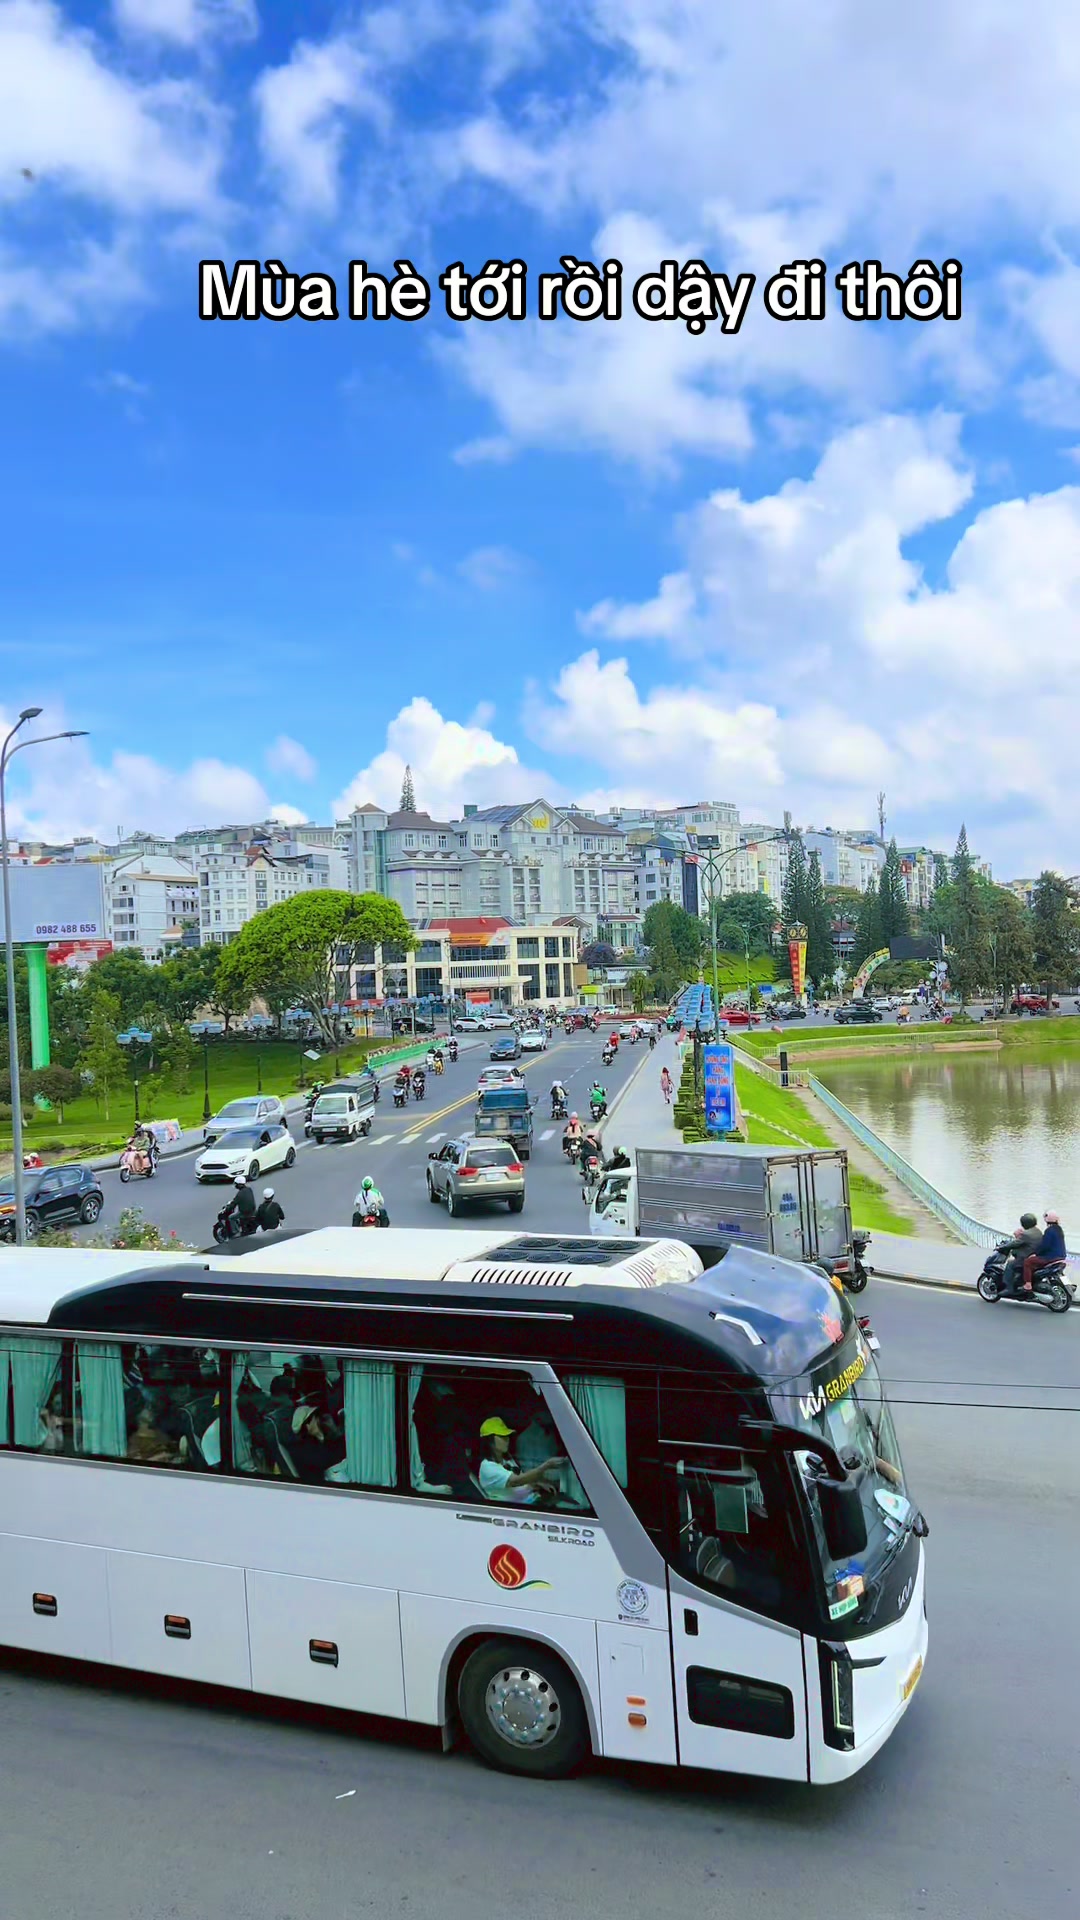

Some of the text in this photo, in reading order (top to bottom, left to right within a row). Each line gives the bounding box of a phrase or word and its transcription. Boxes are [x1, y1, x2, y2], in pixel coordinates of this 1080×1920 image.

[36, 924, 97, 934] 0982 488 655
[825, 1355, 865, 1402] GRANBIRD
[493, 1518, 595, 1537] GRANBIRD
[547, 1535, 595, 1547] SILKROAD
